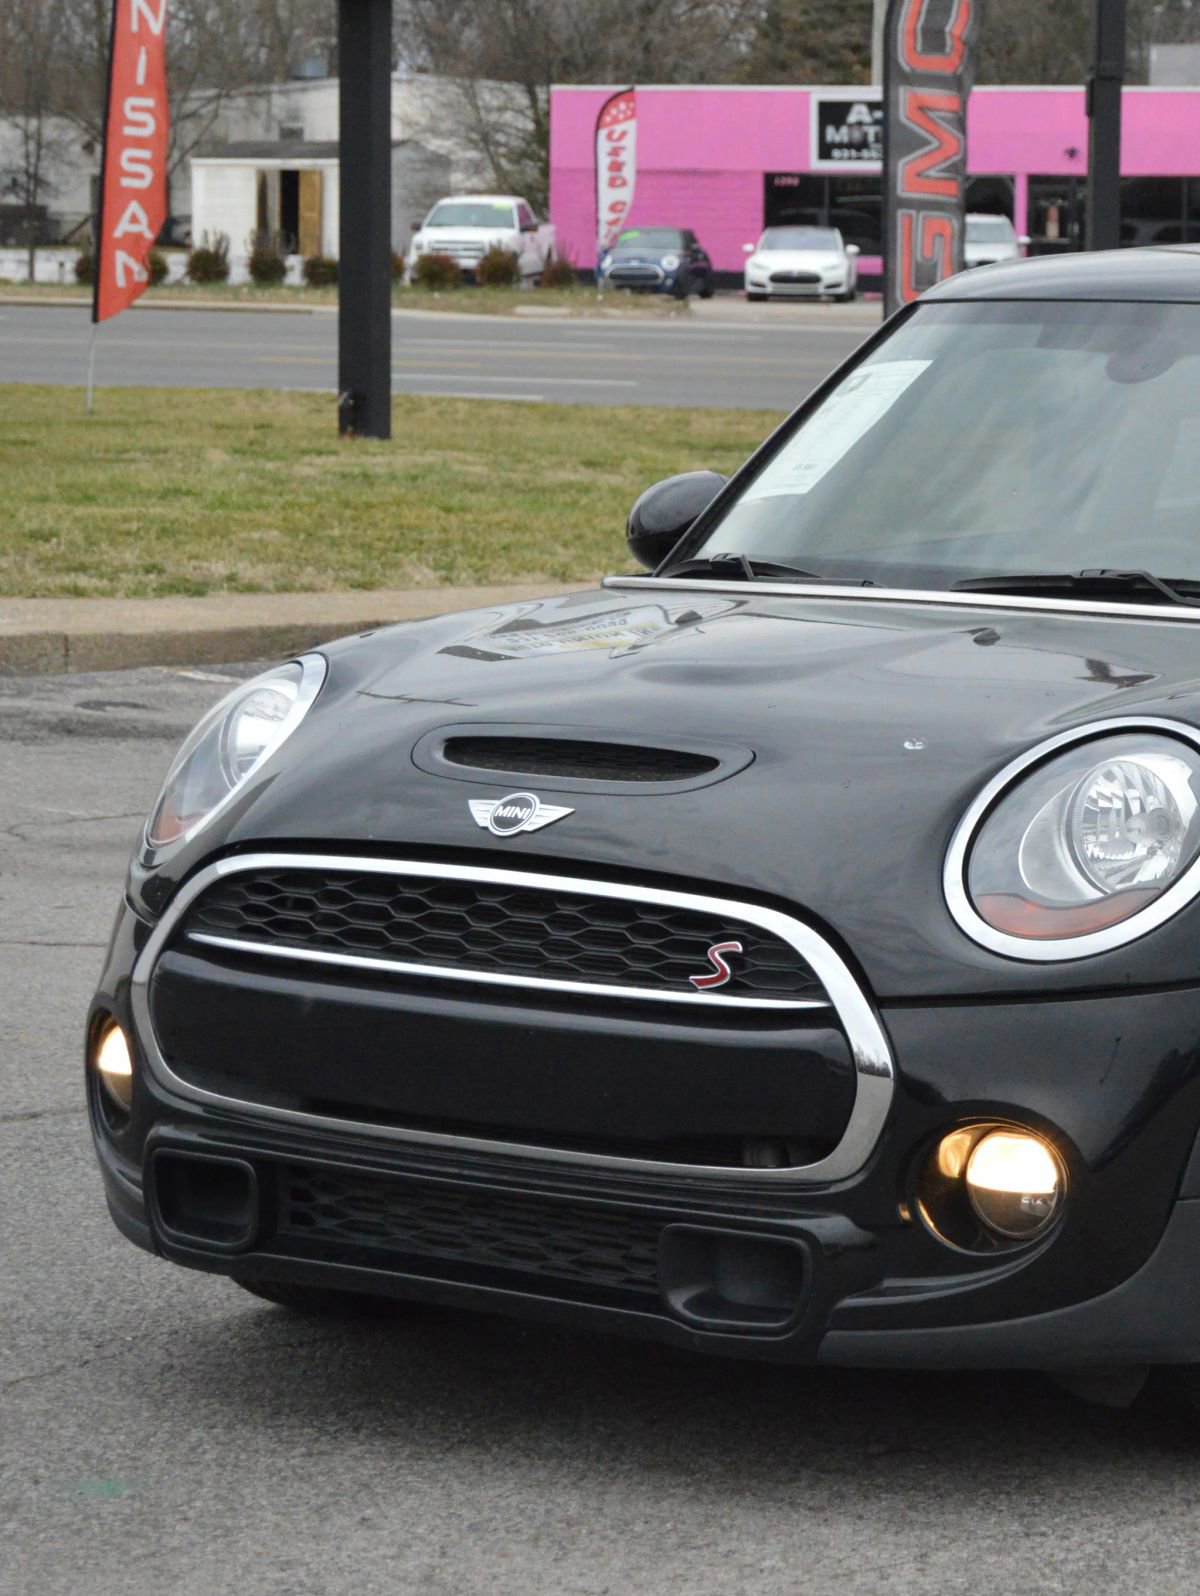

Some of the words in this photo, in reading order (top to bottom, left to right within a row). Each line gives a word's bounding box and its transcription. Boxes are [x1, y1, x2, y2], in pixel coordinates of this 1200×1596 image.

[113, 0, 165, 288] NISSAN
[897, 0, 970, 305] GMC
[494, 805, 532, 820] MINI
[689, 941, 743, 990] S
